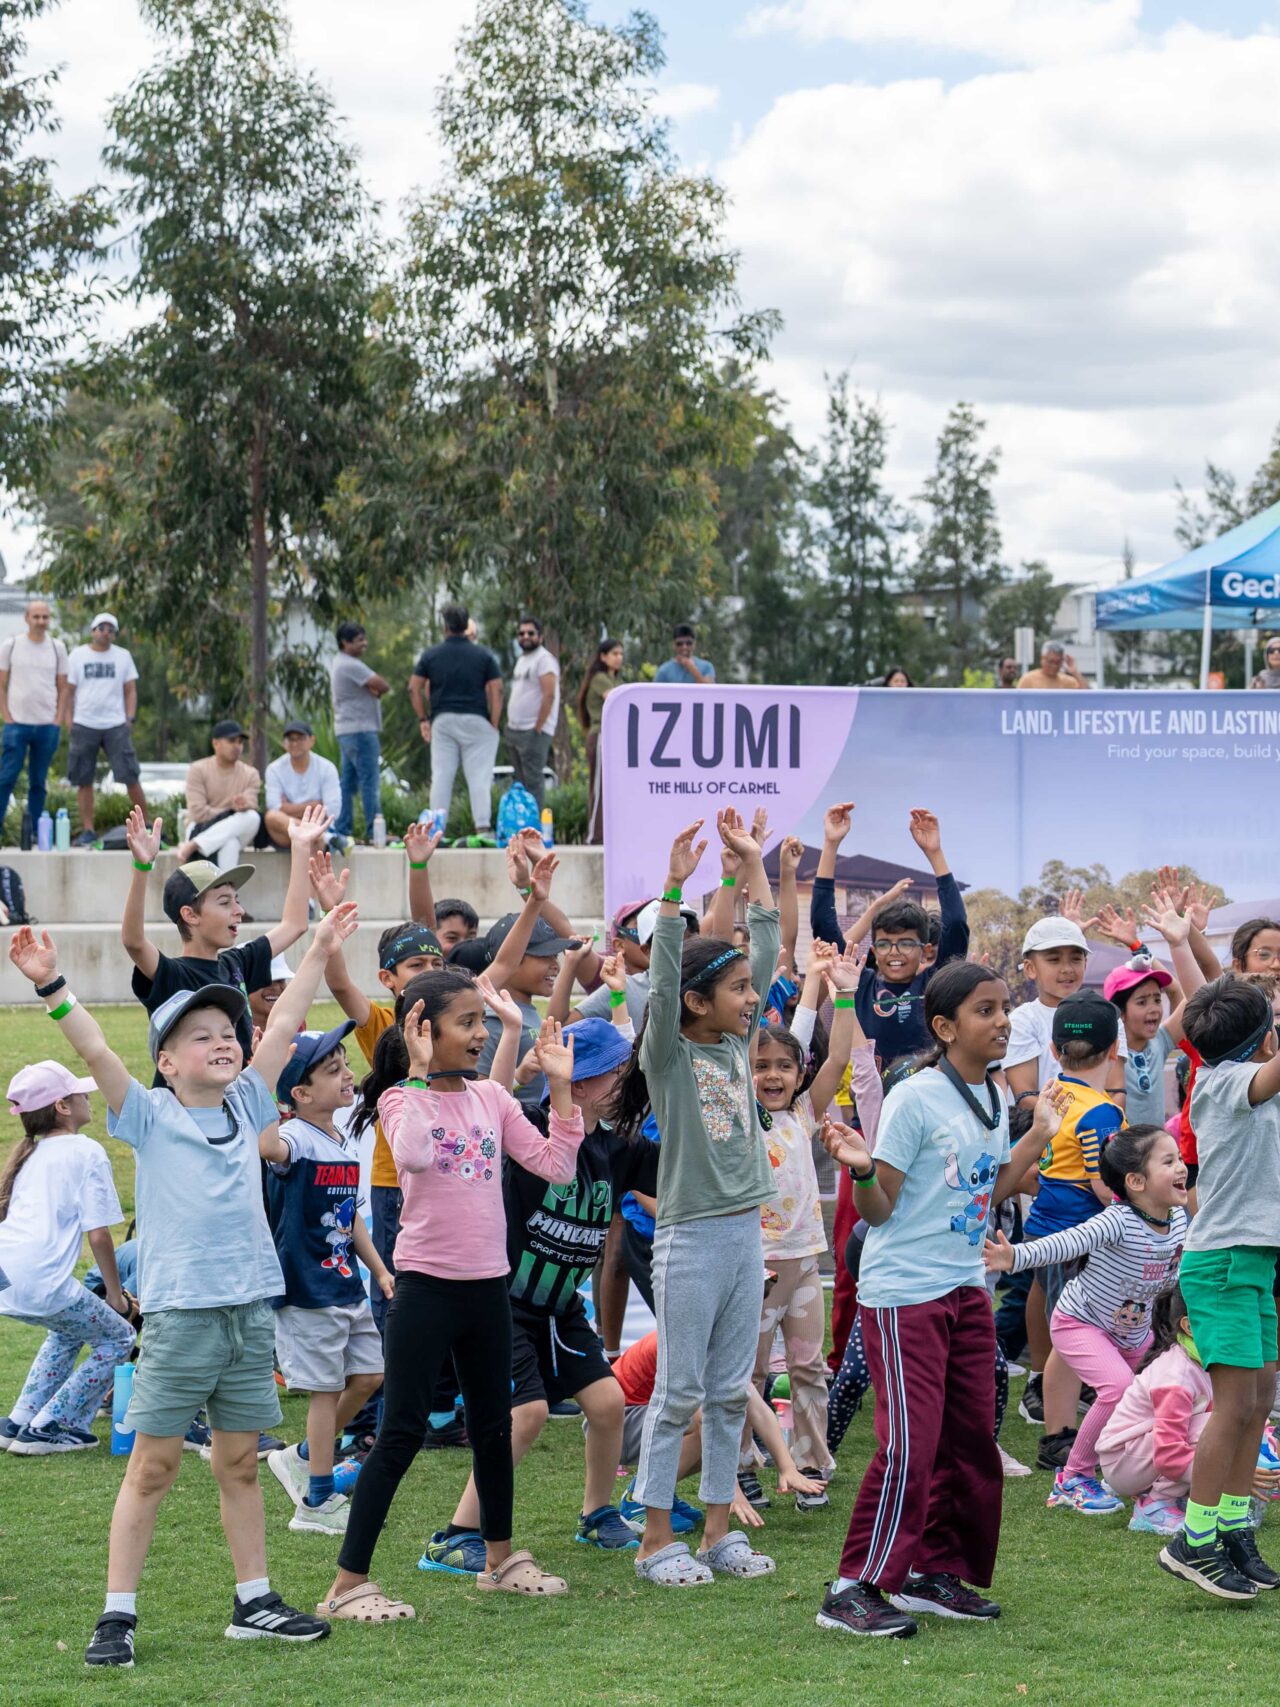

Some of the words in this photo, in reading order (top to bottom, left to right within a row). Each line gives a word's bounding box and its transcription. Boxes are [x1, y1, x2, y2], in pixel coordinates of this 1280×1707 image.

[1001, 709, 1058, 737] LAND,
[1063, 709, 1162, 735] LIFESTYLE
[1167, 710, 1207, 735] AND
[627, 702, 800, 769] IZUMI
[1107, 744, 1141, 758] Find
[1144, 747, 1177, 764] your
[1181, 747, 1229, 764] space,
[1233, 744, 1271, 759] build
[648, 781, 671, 794] THE
[674, 781, 702, 794] HILLS
[706, 781, 726, 794] OF
[728, 781, 780, 794] CARMEL
[314, 1165, 345, 1186] TEAM
